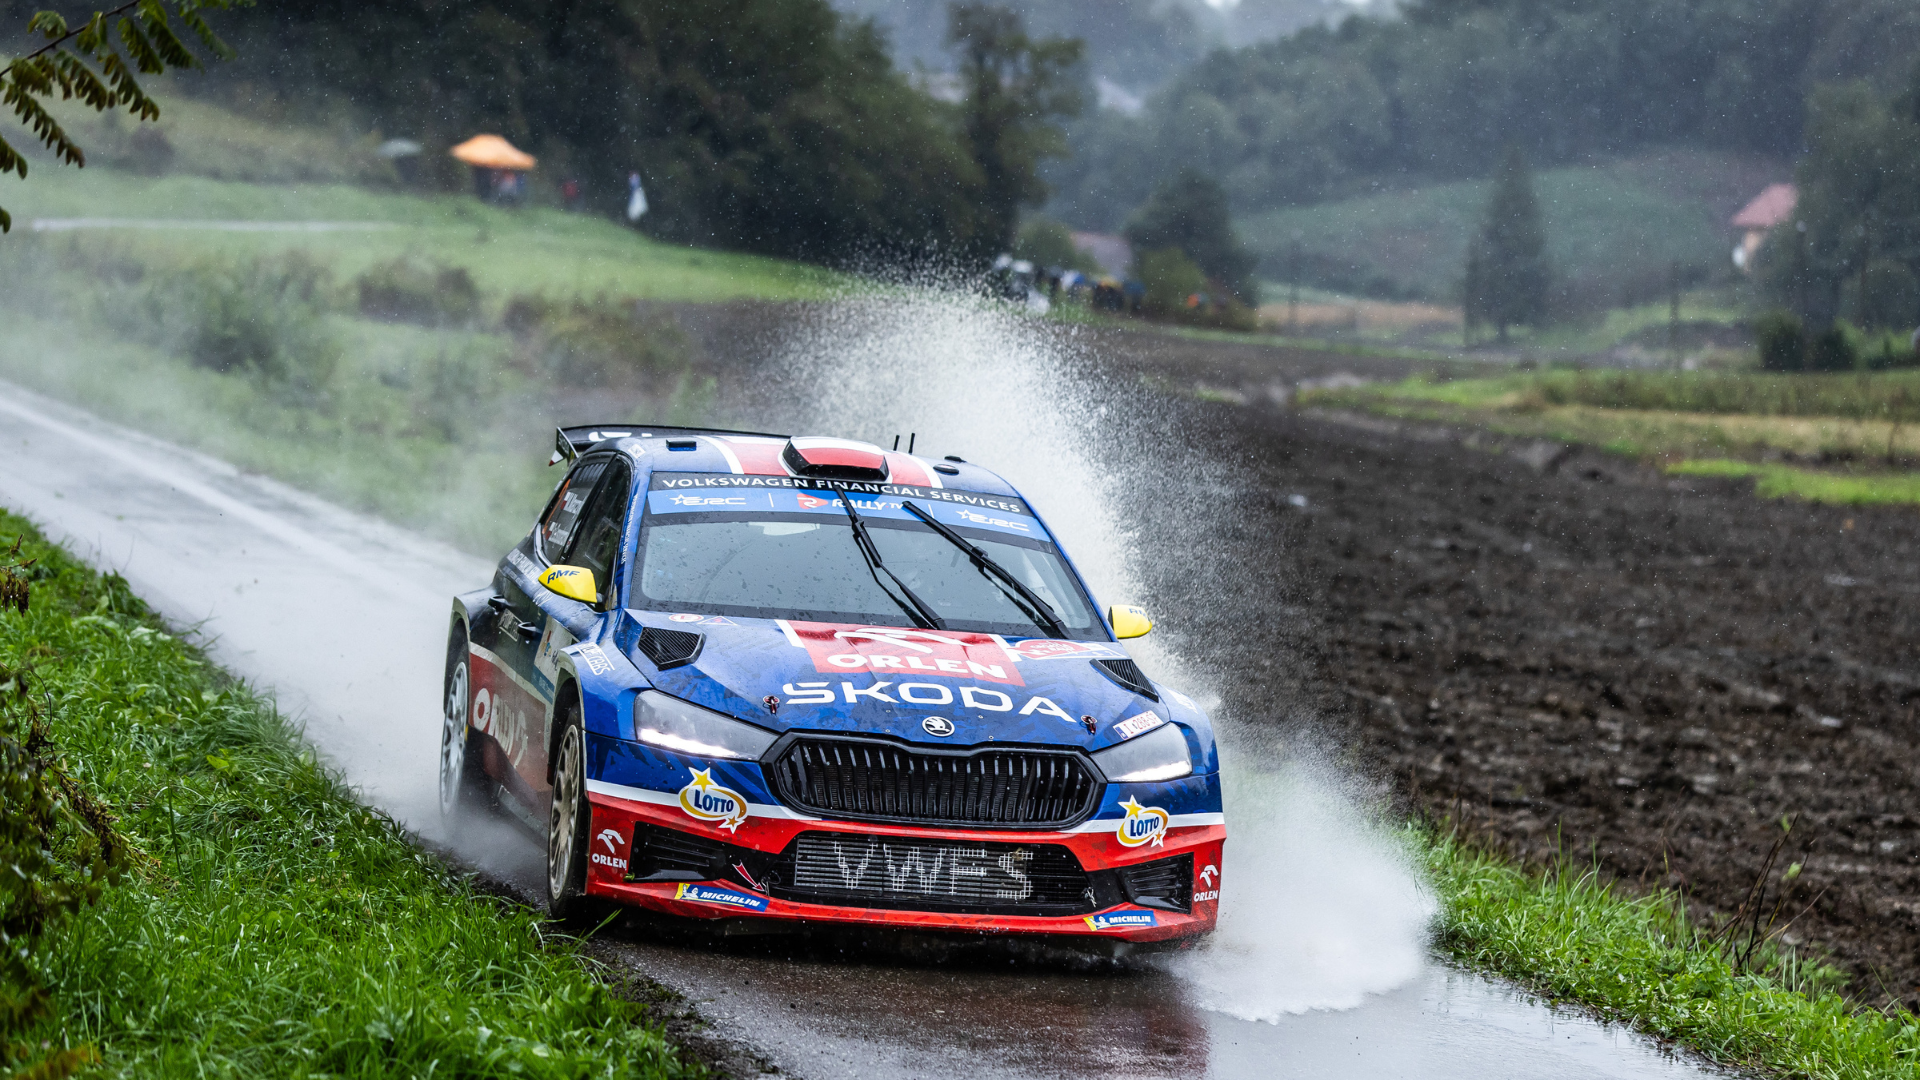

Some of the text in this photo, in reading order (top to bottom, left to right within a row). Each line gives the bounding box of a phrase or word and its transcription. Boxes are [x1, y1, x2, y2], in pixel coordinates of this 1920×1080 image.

[662, 477, 1021, 513] VOLKSWAGEN FINANCIAL SERVICES
[675, 494, 747, 506] ERC
[964, 511, 1030, 532] ERC
[547, 570, 580, 584] RMF
[827, 654, 1008, 679] ORLEN
[693, 790, 734, 813] LOTTO
[1130, 814, 1160, 837] LOTTO
[592, 853, 628, 870] ORLEN
[833, 841, 1034, 900] VWFS
[700, 891, 760, 908] MICHELIN
[1193, 889, 1219, 903] ORLEN
[1108, 914, 1152, 925] MICHELIN
